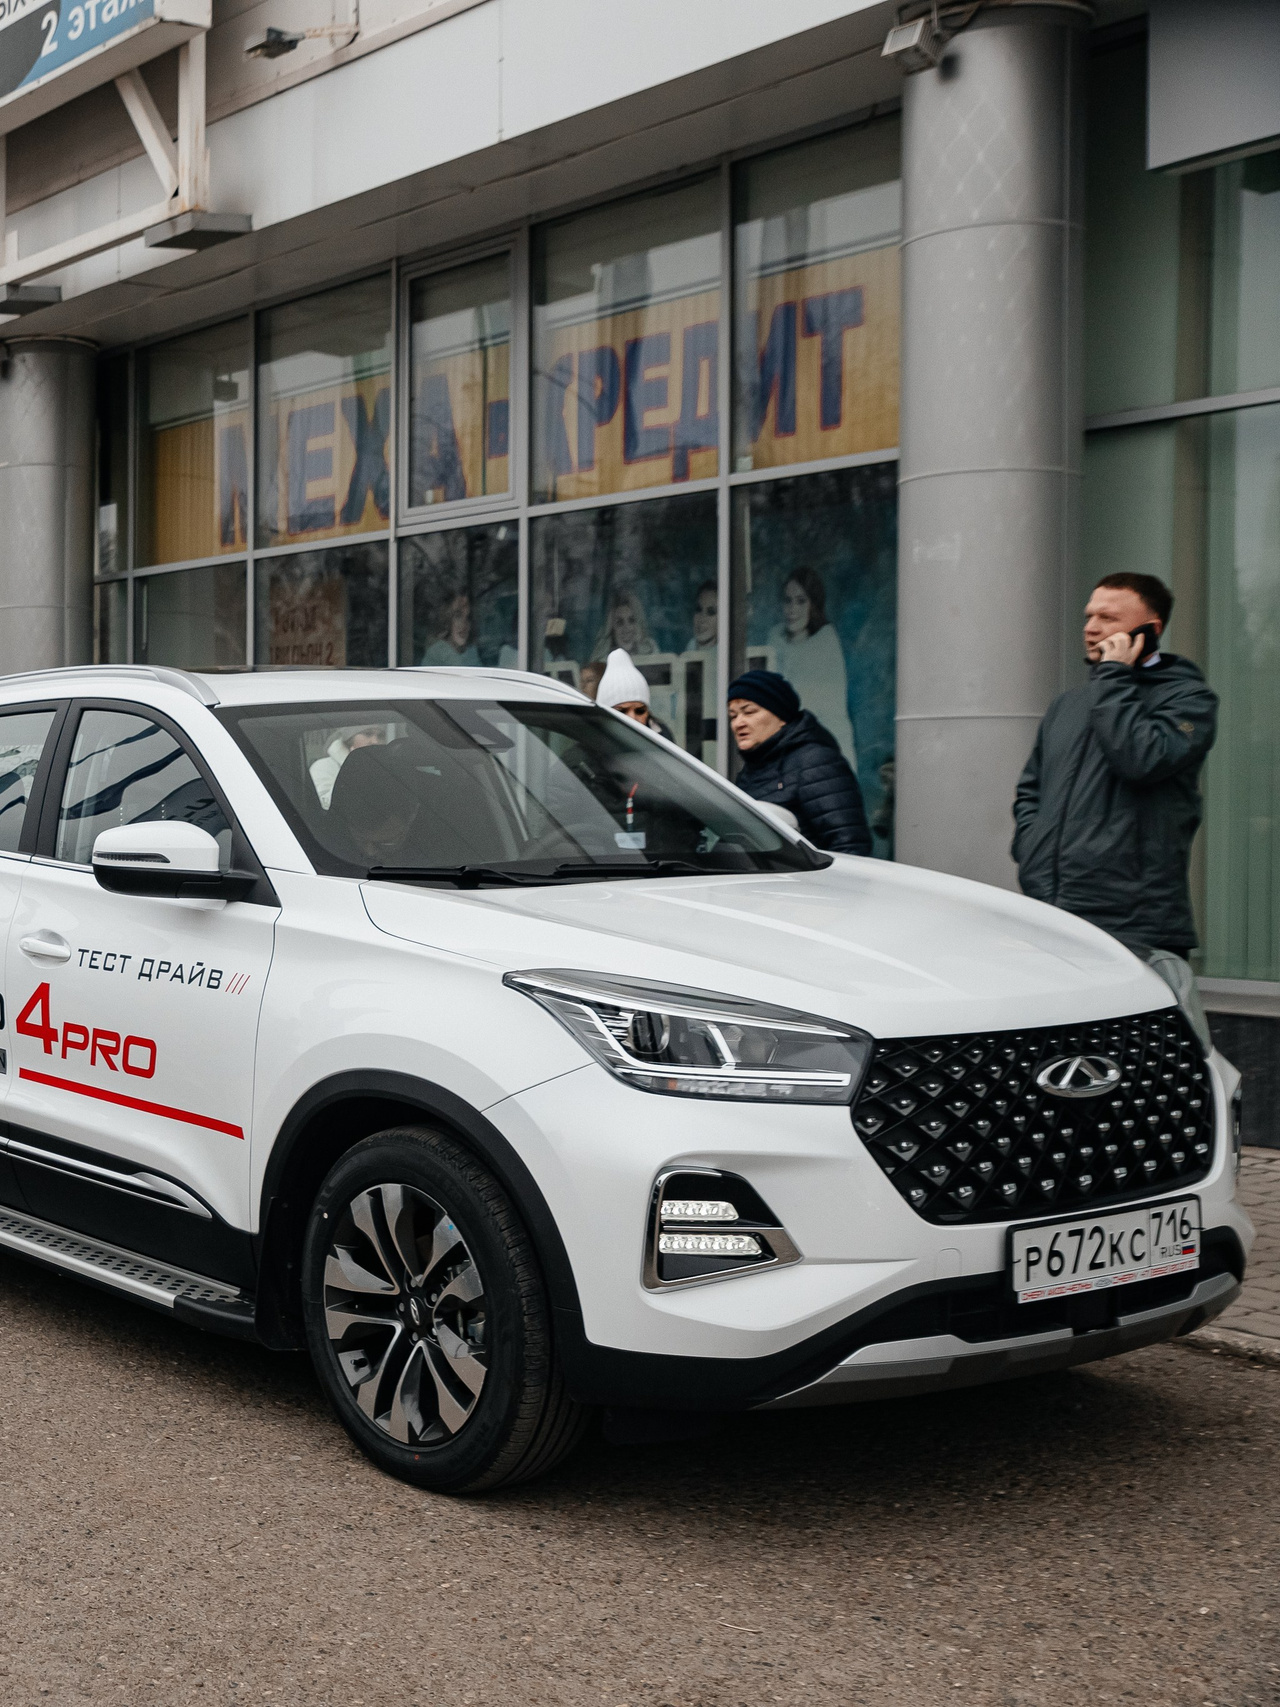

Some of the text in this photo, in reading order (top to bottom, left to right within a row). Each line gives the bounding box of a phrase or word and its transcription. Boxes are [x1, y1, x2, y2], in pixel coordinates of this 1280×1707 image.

[40, 10, 59, 58] 2
[78, 948, 224, 991] ТЕСТ ДРАЙВ
[1151, 1207, 1192, 1246] 716
[1160, 1243, 1181, 1259] RUS
